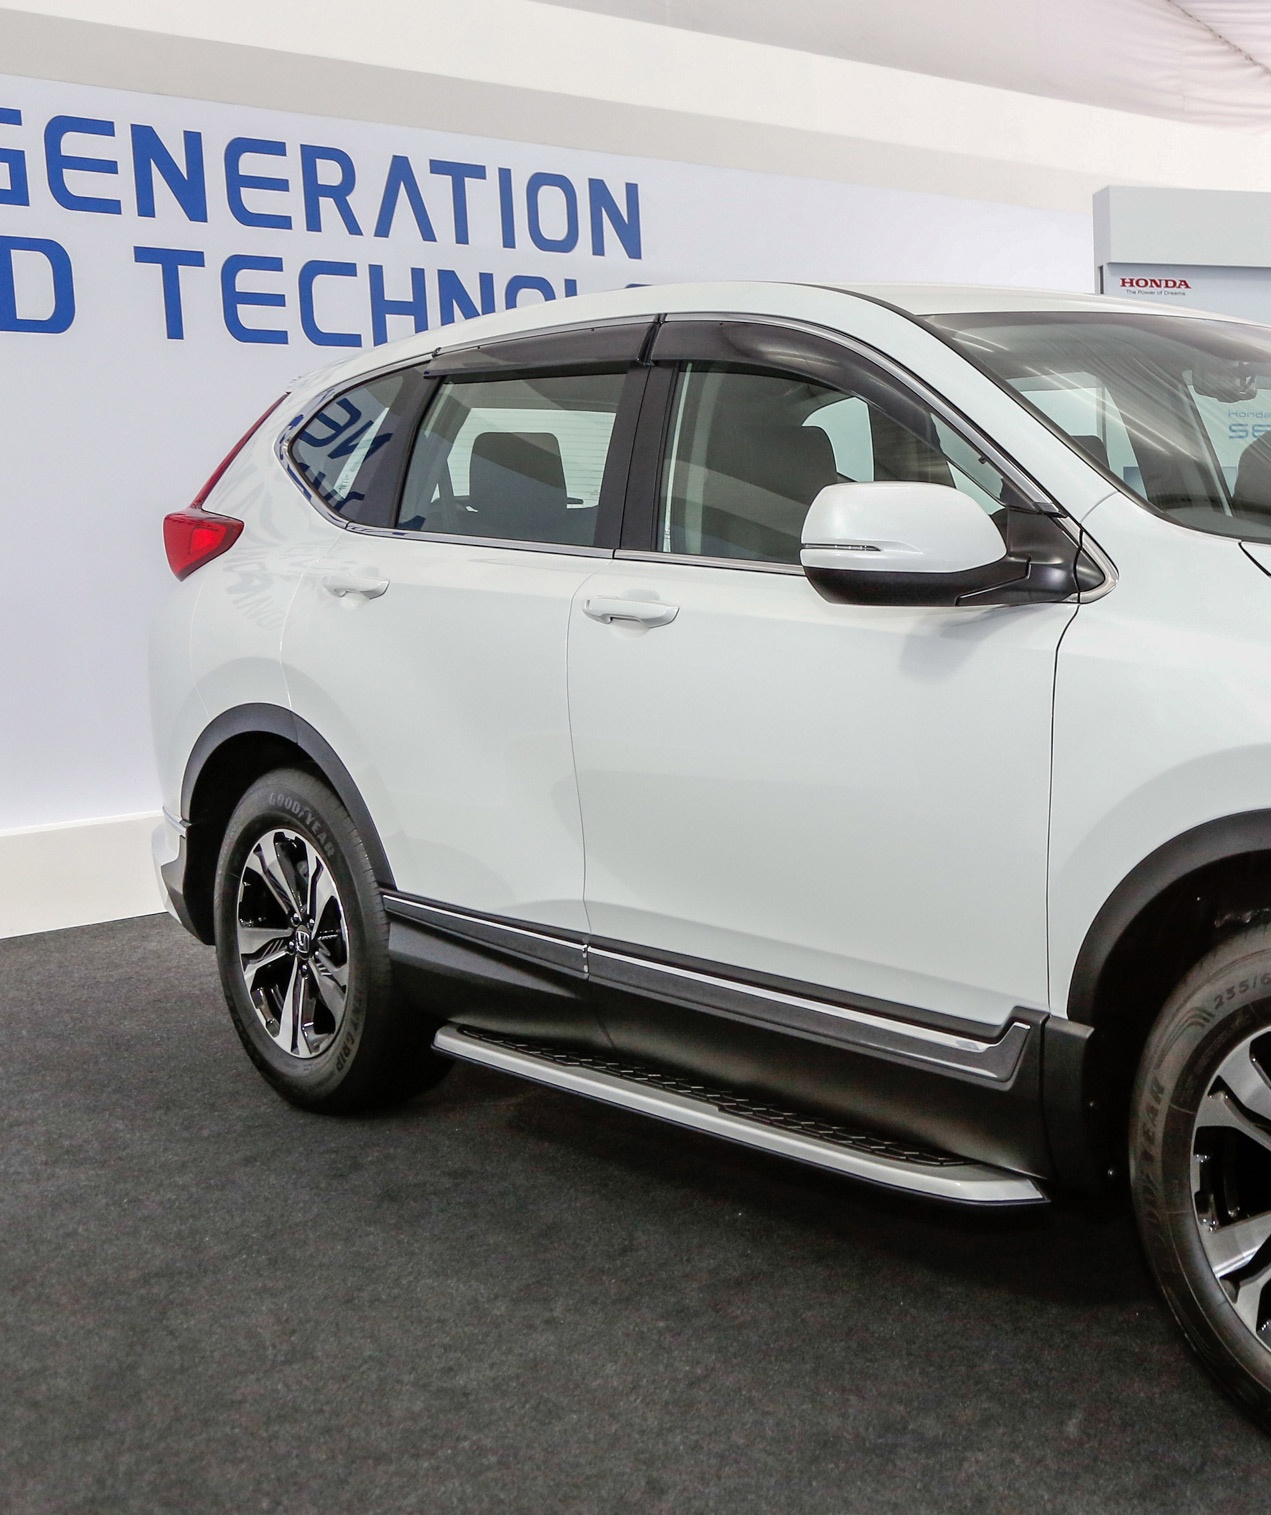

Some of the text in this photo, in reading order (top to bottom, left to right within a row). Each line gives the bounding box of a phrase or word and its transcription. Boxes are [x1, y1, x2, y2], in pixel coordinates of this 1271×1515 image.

[134, 245, 653, 348] TECHN
[1120, 277, 1192, 289] HONDA
[268, 792, 336, 858] GOODYEAR
